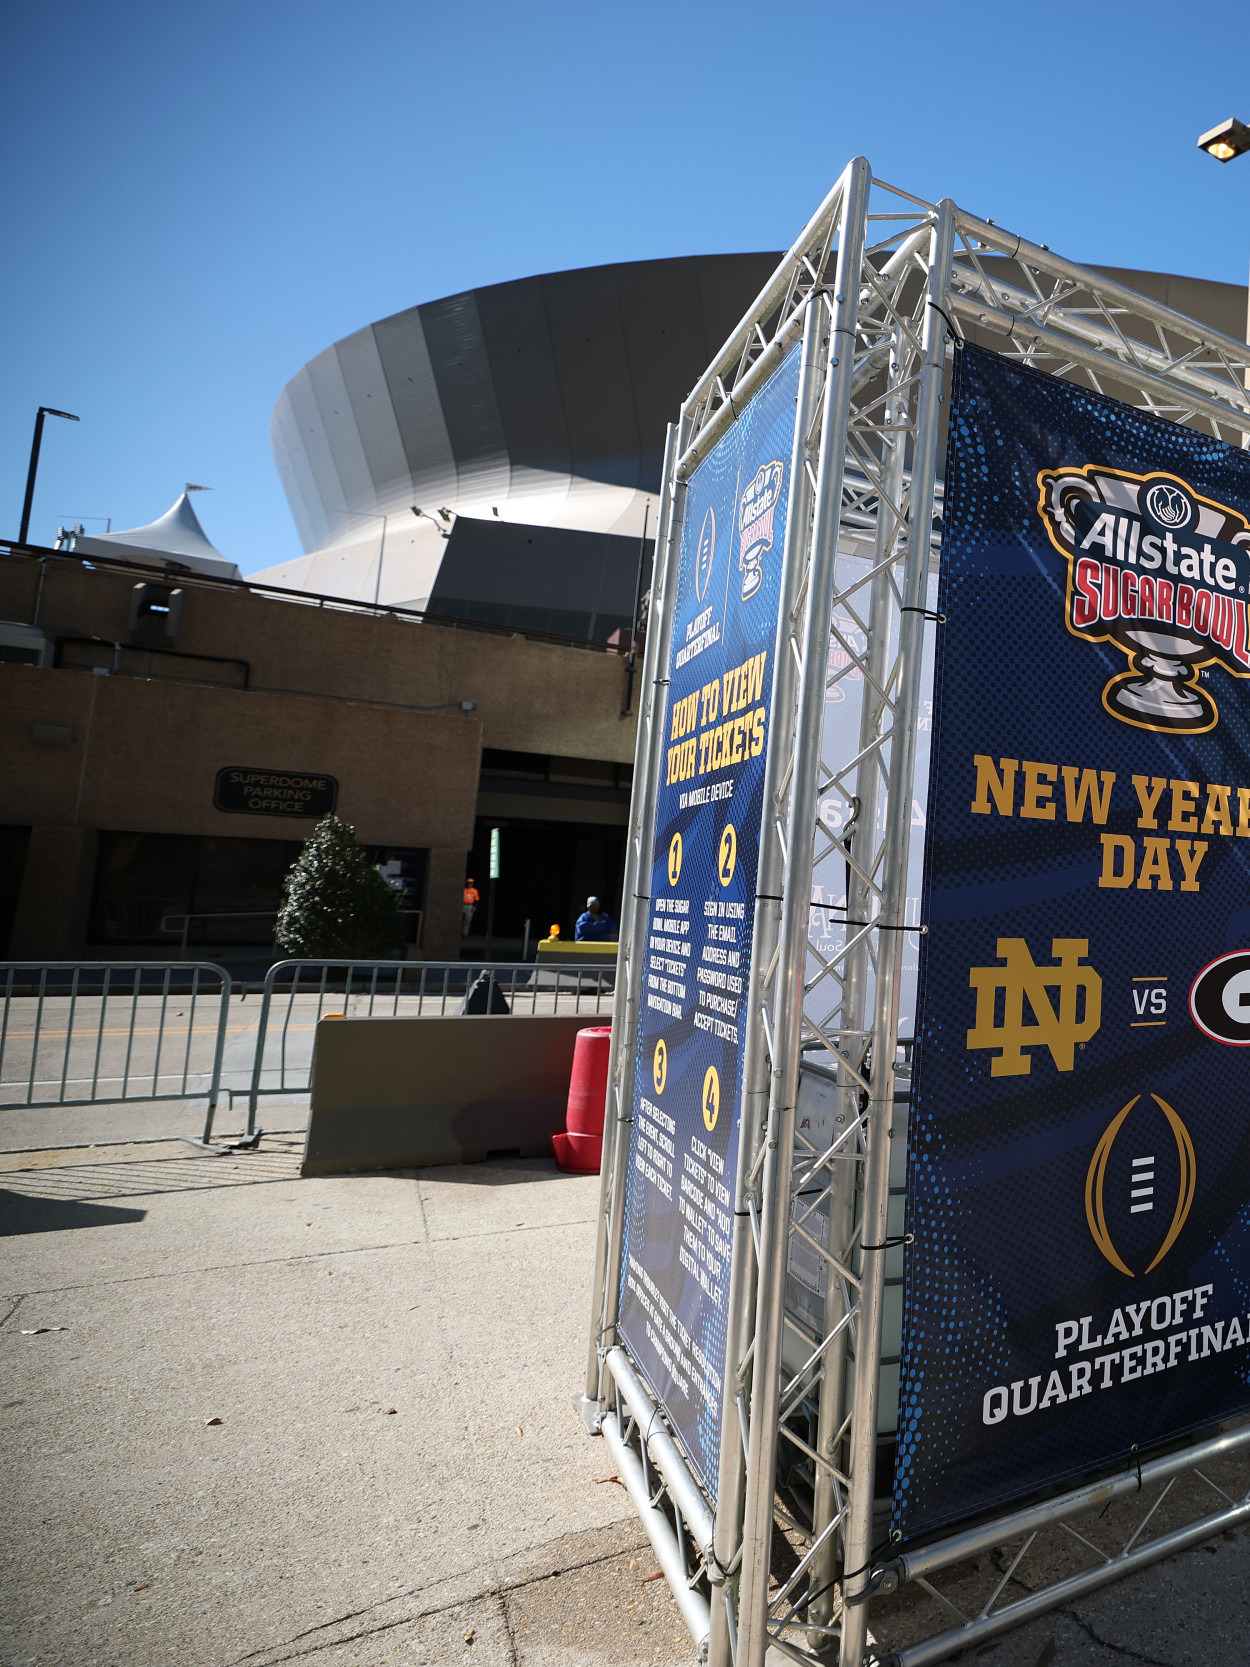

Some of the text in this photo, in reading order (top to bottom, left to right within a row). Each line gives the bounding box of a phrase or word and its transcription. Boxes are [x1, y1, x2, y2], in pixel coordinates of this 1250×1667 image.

[741, 489, 772, 529] Allstate
[1080, 512, 1237, 592] Allstate
[1073, 557, 1175, 628] SUGAR
[686, 606, 713, 642] PLAYOFF
[676, 622, 720, 669] QUARTERFINAL
[671, 651, 766, 741] HOW TO VIEW
[666, 706, 766, 786] YOUR TICKETS
[230, 772, 327, 790] SUPERDOME
[243, 785, 312, 801] PARKING
[679, 779, 734, 809] VIA MOBILE DEVICE
[970, 754, 1116, 825] NEW
[248, 798, 304, 812] OFFICE
[671, 839, 680, 879] 1
[721, 834, 733, 879] 2
[1098, 832, 1208, 892] DAY
[673, 900, 689, 914] SUGAR
[704, 901, 745, 920] SIGN IN USING
[664, 919, 680, 934] MOBILE
[680, 921, 690, 935] APP
[708, 924, 736, 943] THE EMAIL
[650, 955, 664, 971] SELECT
[666, 939, 681, 955] DEVICE
[681, 942, 691, 957] AND
[702, 946, 740, 968] ADDRESS AND
[660, 977, 668, 992] THE
[667, 980, 686, 999] BOTTOM
[697, 967, 742, 994] PASSWORD USED
[699, 990, 706, 1006] TO
[1132, 988, 1167, 1015] VS
[693, 1011, 738, 1044] ACCEPT TICKETS.
[655, 1048, 665, 1087] 3
[640, 1097, 675, 1135] AFTER SELECTING
[706, 1073, 716, 1124] 4
[638, 1114, 646, 1132] THE
[659, 1132, 675, 1158] SCROLL
[691, 1136, 707, 1161] CLICK
[638, 1135, 647, 1154] LEFT
[653, 1149, 666, 1172] RIGHT
[666, 1160, 673, 1178] TO
[644, 1162, 657, 1185] EACH
[681, 1174, 704, 1209] BARCODE
[703, 1197, 715, 1220] AND
[707, 1173, 715, 1193] TO
[715, 1180, 730, 1208] VIEW
[679, 1195, 685, 1214] TO
[708, 1225, 715, 1246] TO
[714, 1234, 731, 1263] SAVE
[679, 1245, 699, 1281] DIGITAL
[683, 1225, 721, 1280] THEM TO YOUR
[677, 1320, 691, 1351] TICKET
[1055, 1284, 1213, 1359] PLAYOFF
[680, 1349, 691, 1375] AND
